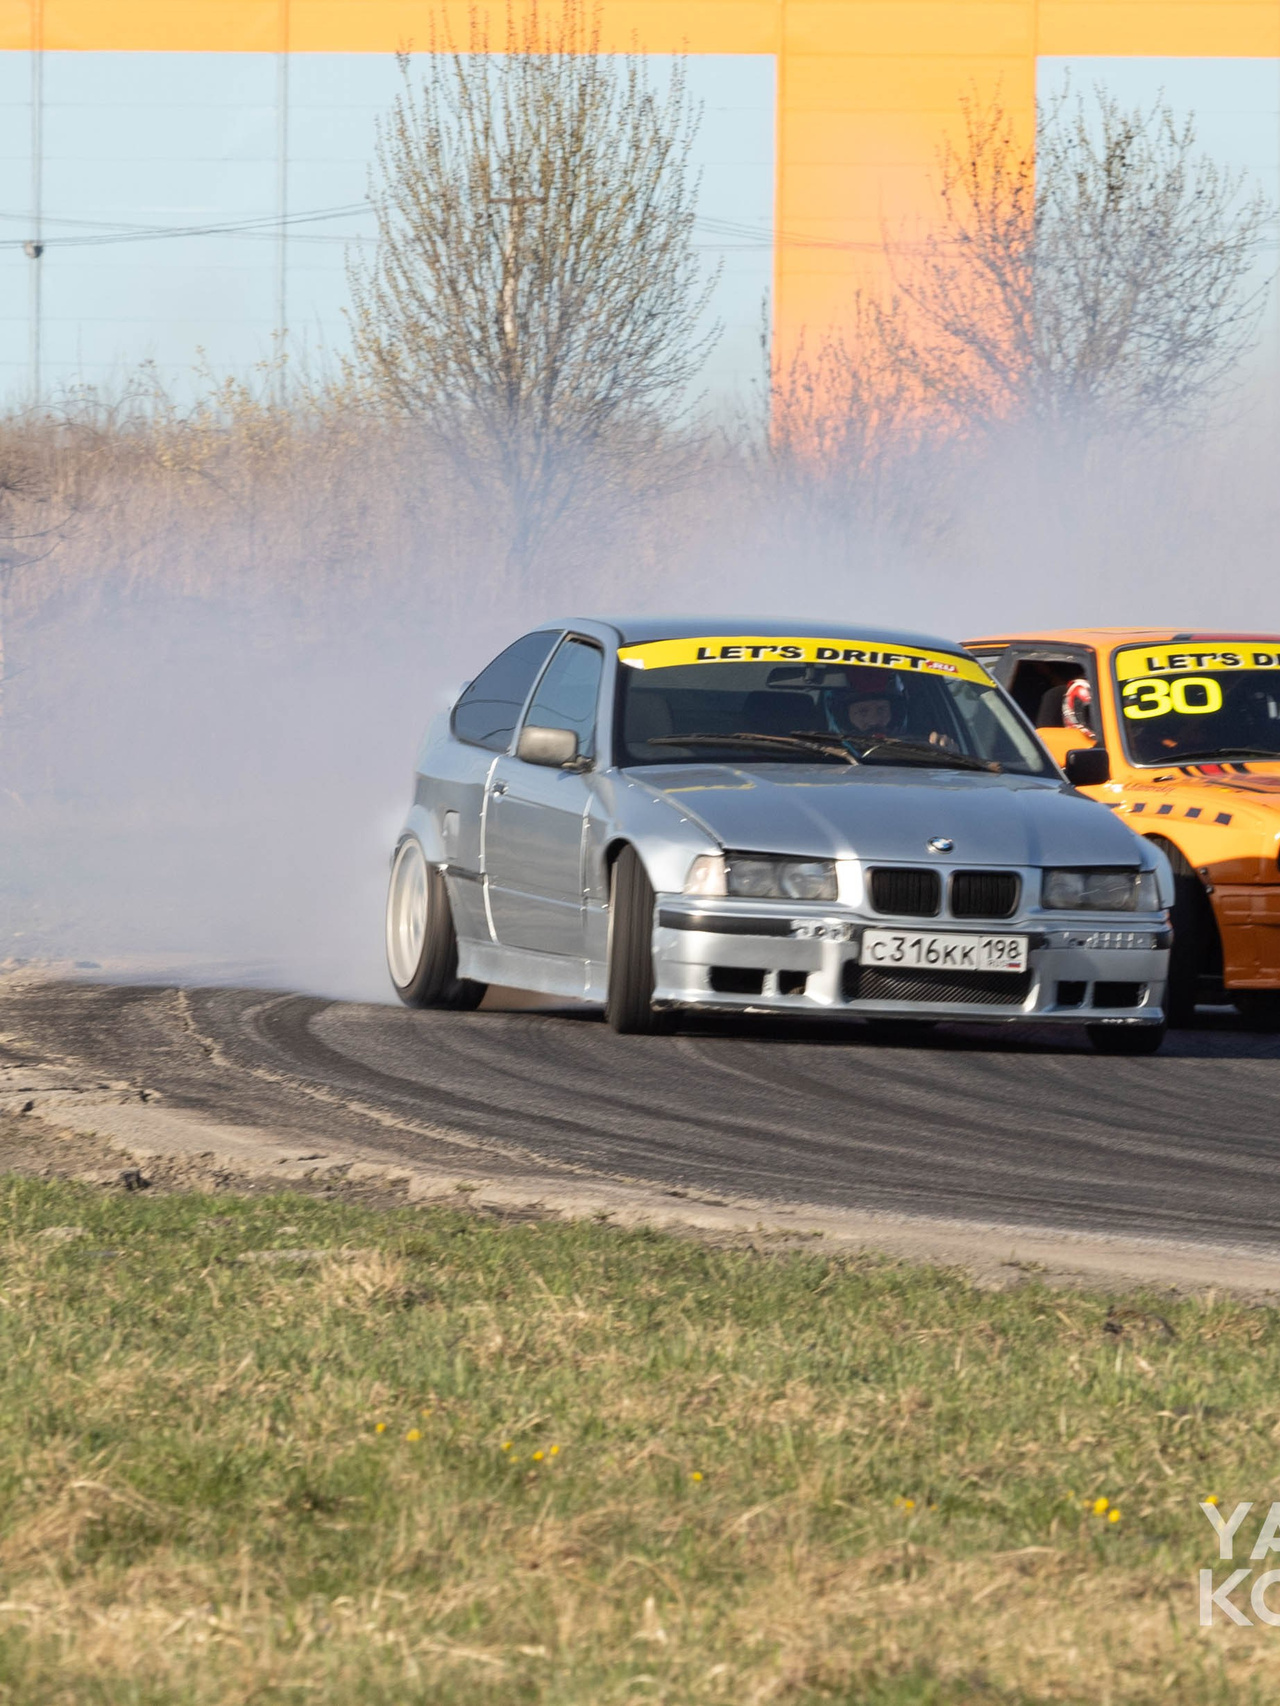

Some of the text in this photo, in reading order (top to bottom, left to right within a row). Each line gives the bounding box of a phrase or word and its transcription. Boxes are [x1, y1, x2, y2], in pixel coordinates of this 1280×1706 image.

[697, 646, 802, 660] LET'S
[1147, 653, 1241, 671] LET'S
[1122, 677, 1223, 720] 30
[982, 939, 1021, 960] 198
